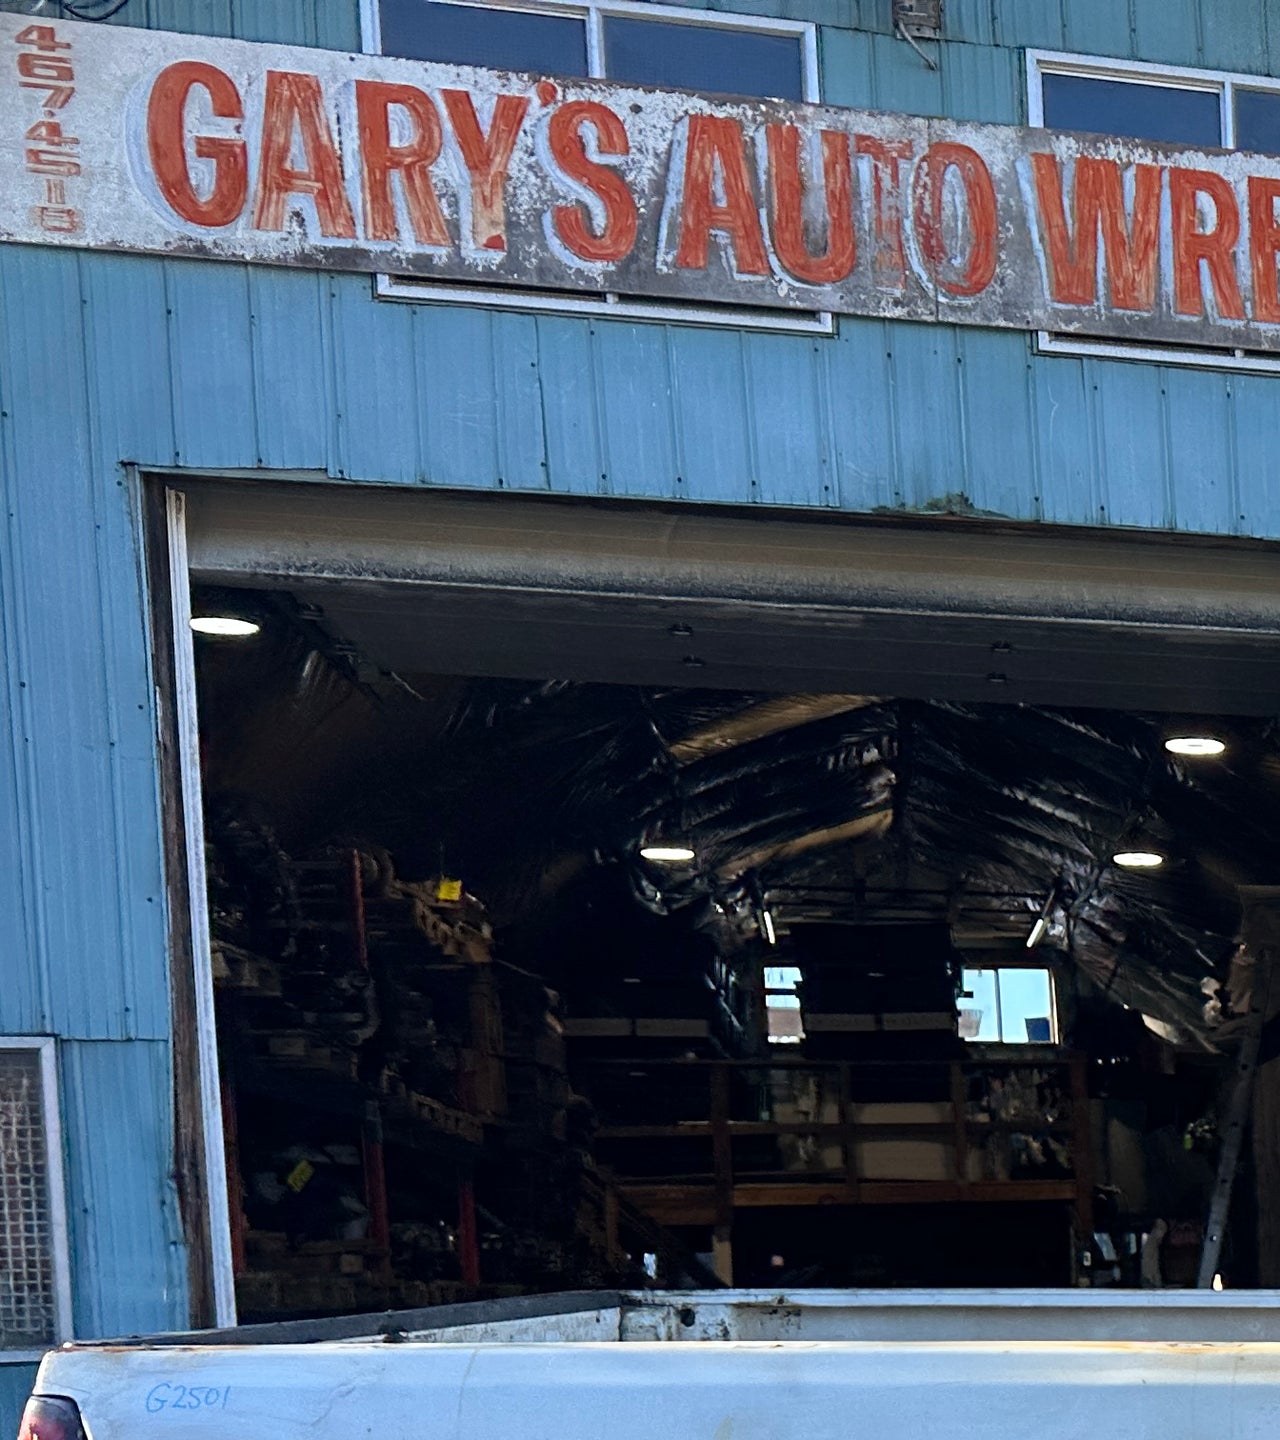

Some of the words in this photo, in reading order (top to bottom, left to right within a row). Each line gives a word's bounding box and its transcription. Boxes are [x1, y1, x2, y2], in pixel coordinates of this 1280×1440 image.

[143, 59, 640, 266] GARY'S
[672, 114, 1000, 300] AUTO
[146, 1382, 232, 1413] G2501
